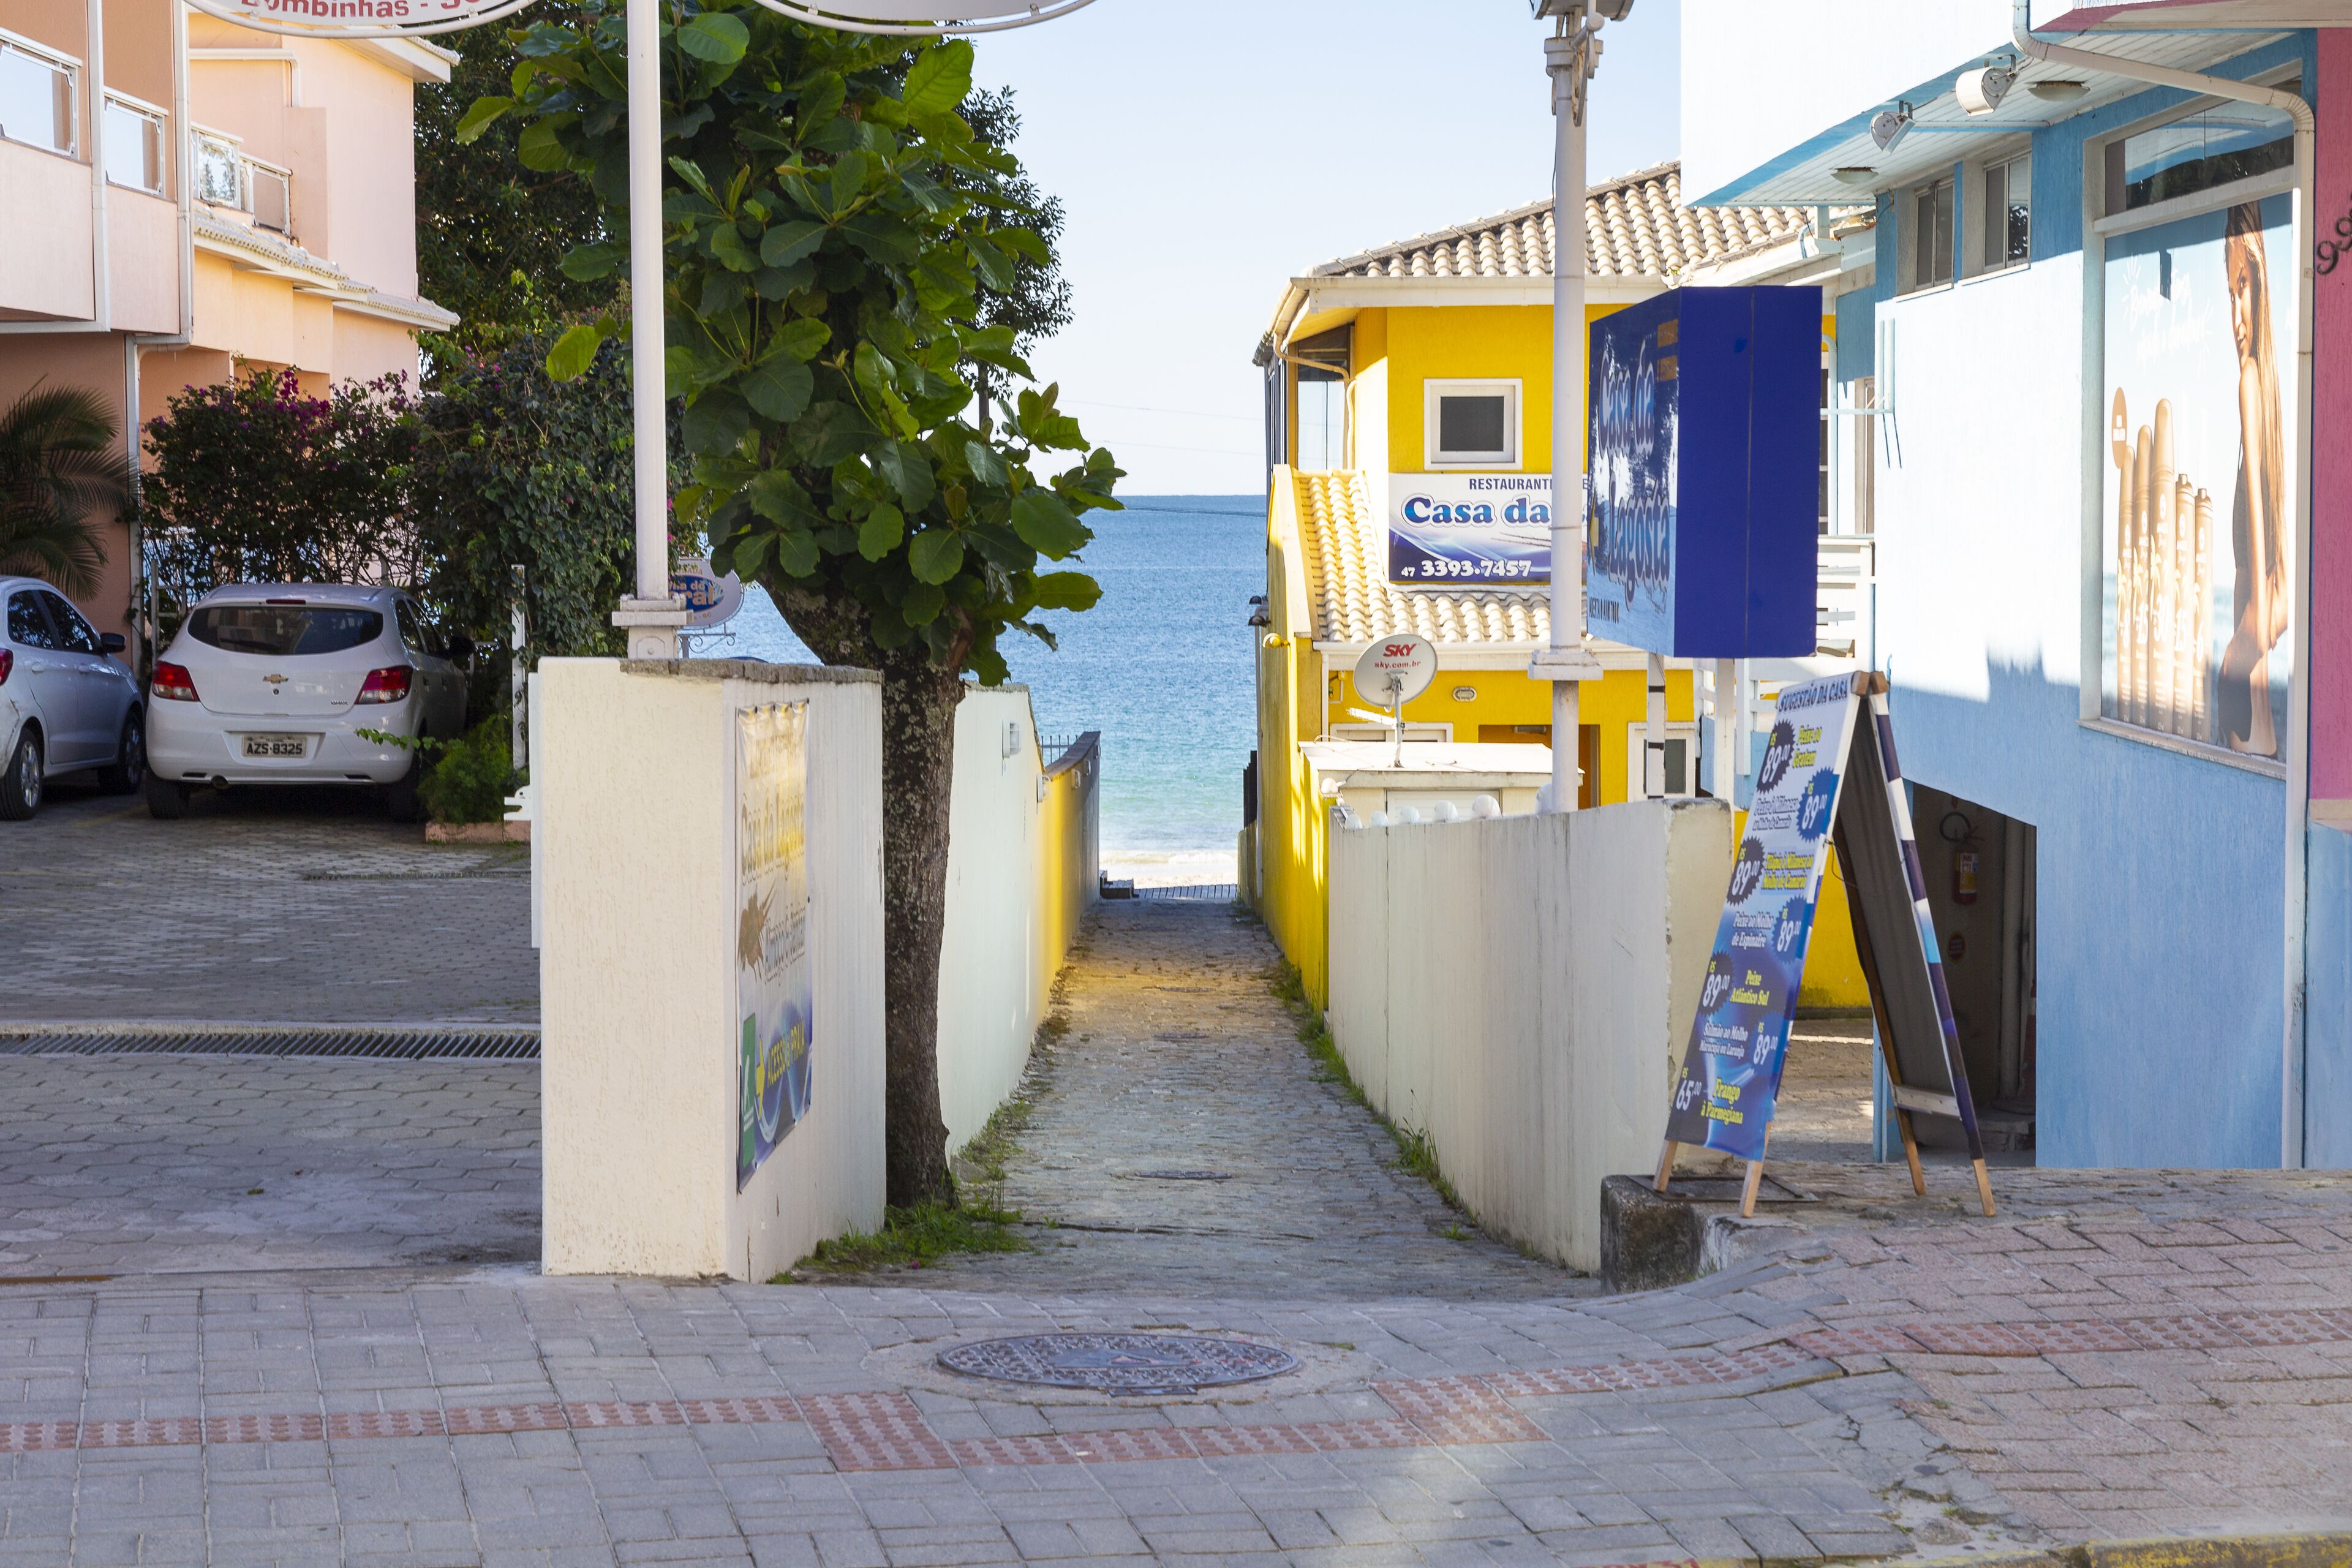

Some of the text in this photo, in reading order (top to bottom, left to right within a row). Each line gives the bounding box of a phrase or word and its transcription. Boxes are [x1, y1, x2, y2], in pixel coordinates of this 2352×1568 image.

[1598, 339, 1654, 461] Casa da
[1469, 478, 1553, 490] RESTAURANT
[1403, 495, 1551, 525] Casa da
[1608, 470, 1670, 612] Lagosta
[1400, 566, 1416, 578] 47
[1383, 643, 1417, 657] SKY
[1374, 660, 1421, 669] sky.com.br
[1816, 685, 1828, 704] DA
[1828, 680, 1848, 702] CASA
[1731, 931, 1766, 951] de Espinafre
[1744, 970, 1762, 987] Peixe
[1729, 986, 1770, 1006] Atlântico Sul
[1703, 1020, 1749, 1042] Salmão ao Molho
[767, 1038, 786, 1089] ACESSO
[790, 1018, 806, 1065] PRAIA
[1725, 1042, 1745, 1060] Laranja
[1713, 1077, 1741, 1106] Frango
[1700, 1099, 1744, 1126] à Parmegiana
